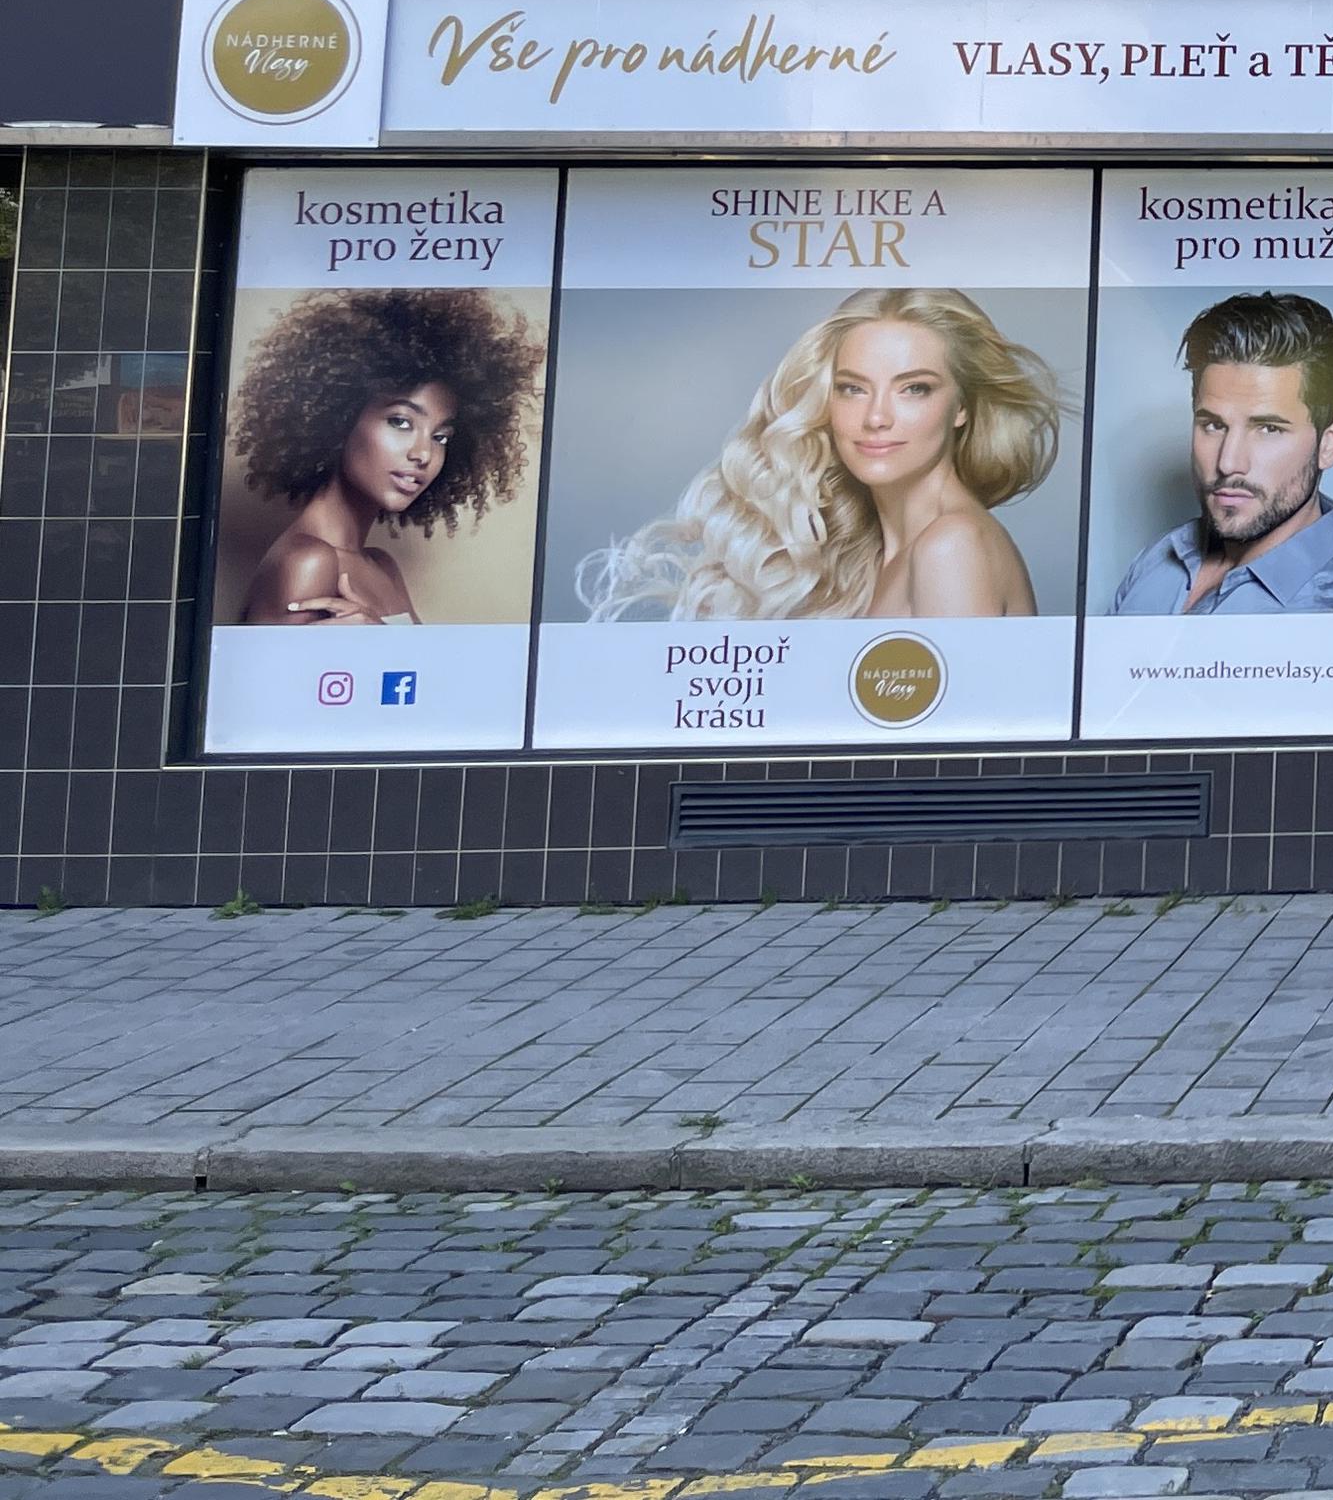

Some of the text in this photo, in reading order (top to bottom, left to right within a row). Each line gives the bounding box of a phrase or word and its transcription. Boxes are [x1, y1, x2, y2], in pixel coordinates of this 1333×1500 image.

[226, 30, 338, 50] NÁDHERNÉ
[428, 10, 554, 86] Vše
[548, 39, 648, 105] pro
[657, 14, 897, 84] nádherné
[952, 42, 1109, 85] VLASY,
[1120, 32, 1237, 78] PLEŤ
[1249, 50, 1272, 78] a
[294, 190, 505, 225] kosmetika
[711, 189, 947, 217] SHINE LIKE A
[327, 228, 504, 272] pro ženy
[748, 220, 911, 270] STAR
[1174, 232, 1240, 270] pro
[665, 635, 790, 674] podpoř
[688, 668, 765, 704] svoji
[674, 700, 766, 729] krásu
